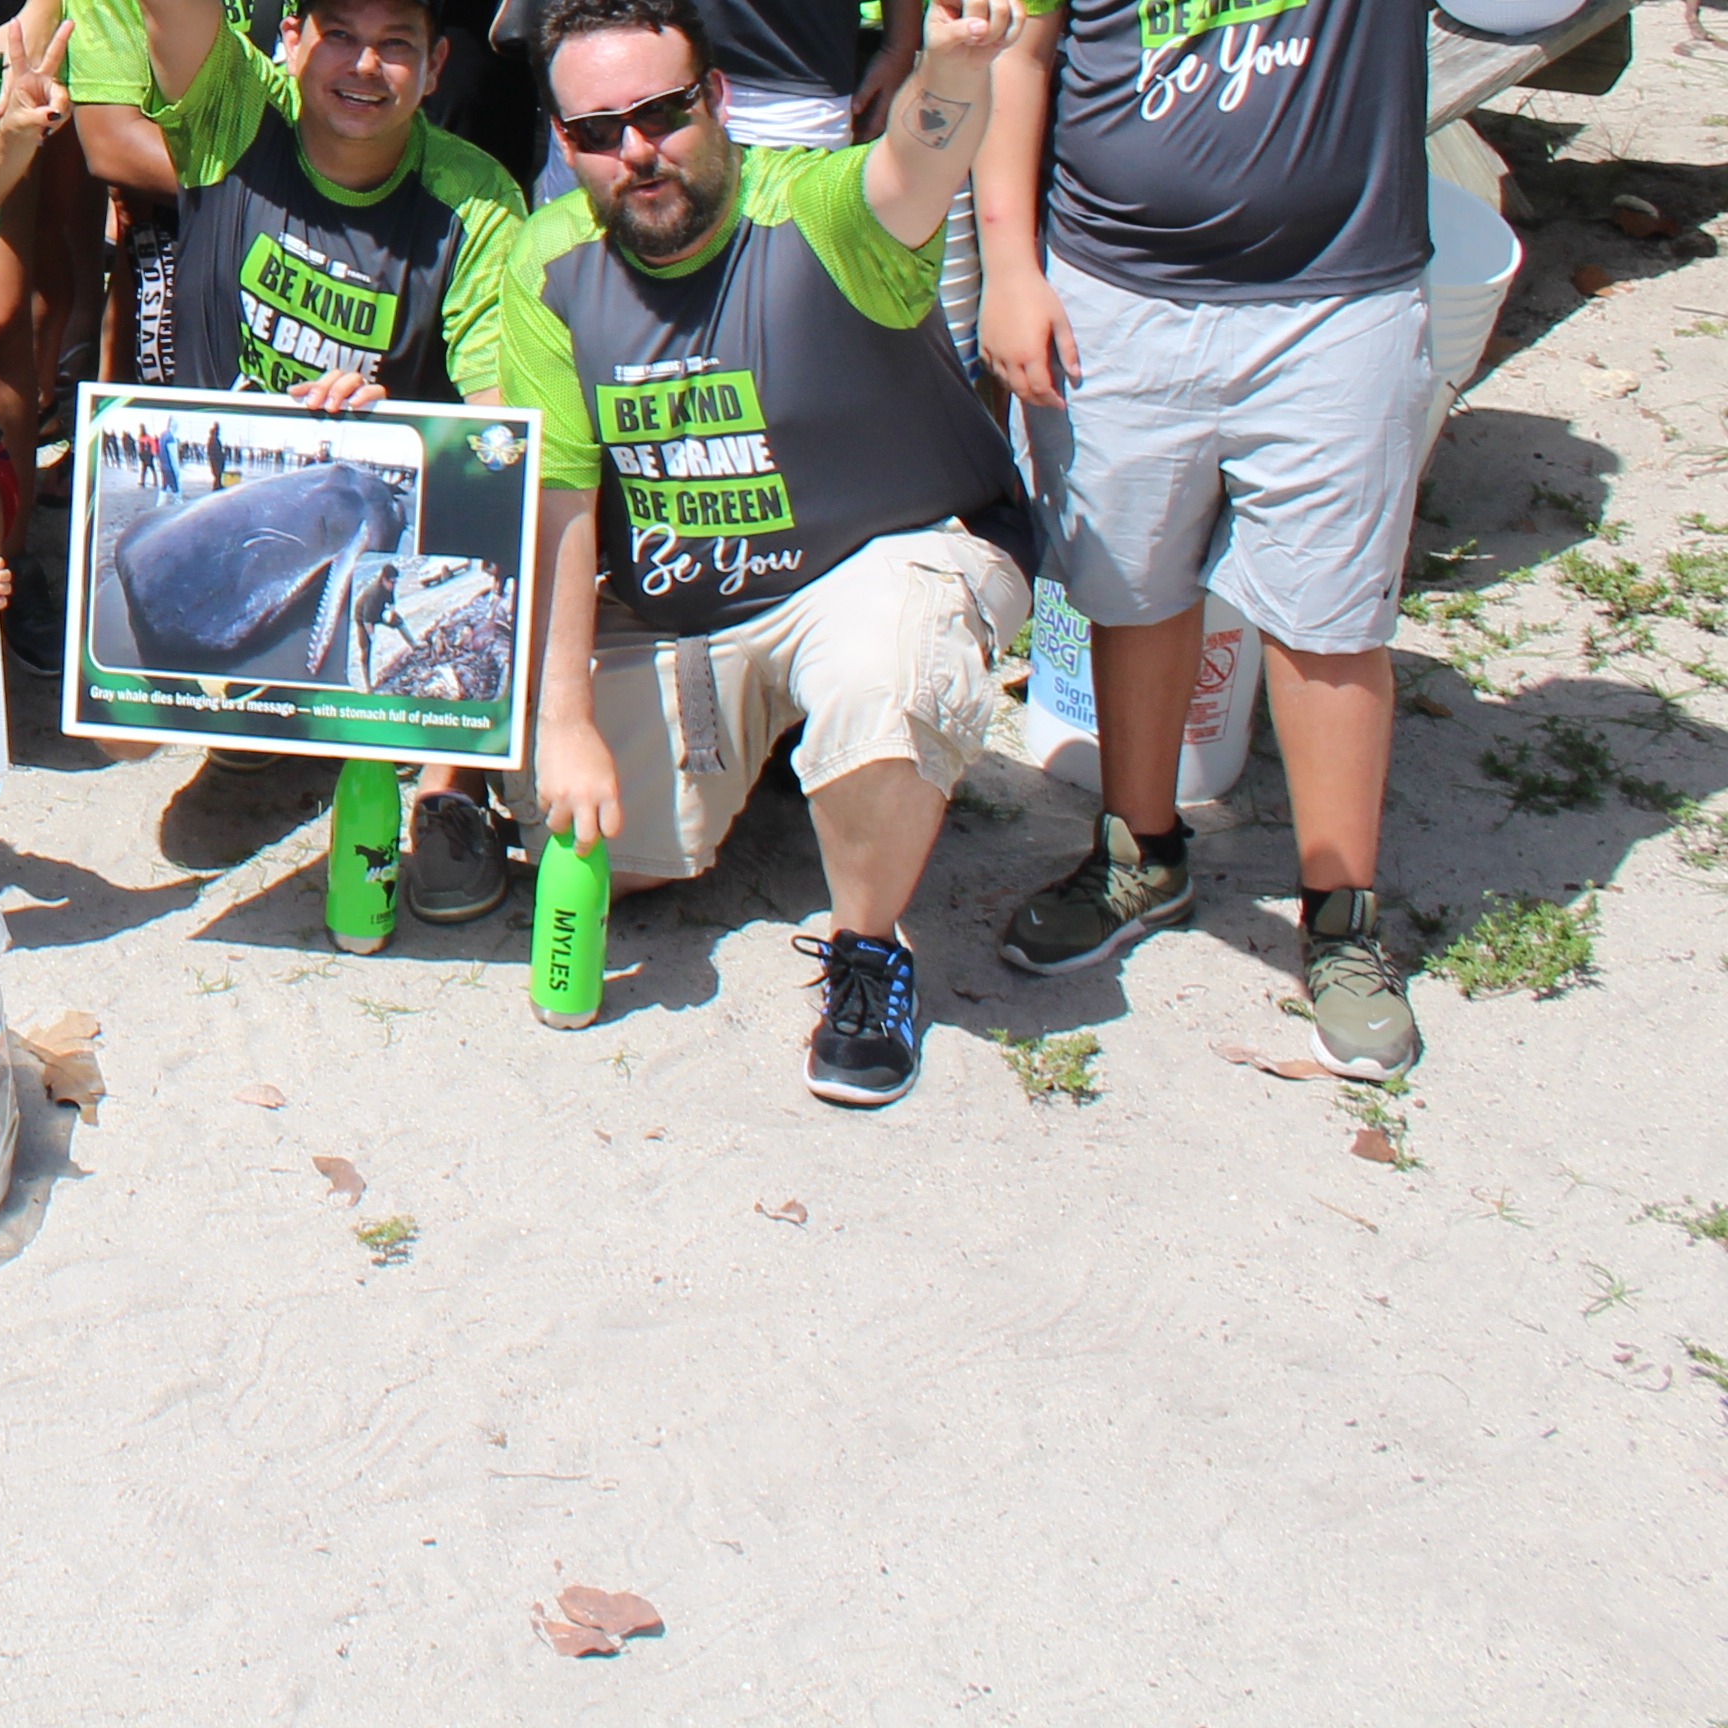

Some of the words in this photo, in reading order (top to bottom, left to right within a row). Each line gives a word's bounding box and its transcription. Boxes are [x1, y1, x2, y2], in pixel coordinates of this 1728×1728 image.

[1135, 35, 1209, 121] Be
[1216, 24, 1311, 112] You
[258, 253, 299, 303] BE
[301, 279, 377, 336] KIND
[273, 315, 382, 383] BRAVE
[614, 395, 660, 432] BE
[609, 444, 661, 478] BE
[660, 433, 776, 477] BRAVE
[628, 487, 670, 522] BE
[676, 486, 784, 526] GREEN
[631, 523, 702, 596] Be
[712, 536, 803, 595] You
[90, 685, 115, 703] Gray
[117, 688, 148, 703] whale
[151, 690, 173, 705] dies
[176, 692, 220, 711] bringing
[221, 698, 235, 710] us
[236, 701, 245, 711] a
[246, 700, 297, 718] message
[312, 704, 337, 718] with
[339, 706, 386, 721] stomach
[388, 709, 406, 722] full
[408, 710, 420, 723] of
[421, 711, 459, 727] plastic
[461, 714, 492, 729] trash
[1054, 677, 1093, 707] Sign
[1056, 699, 1097, 725] onlin
[549, 907, 577, 992] MYLES
